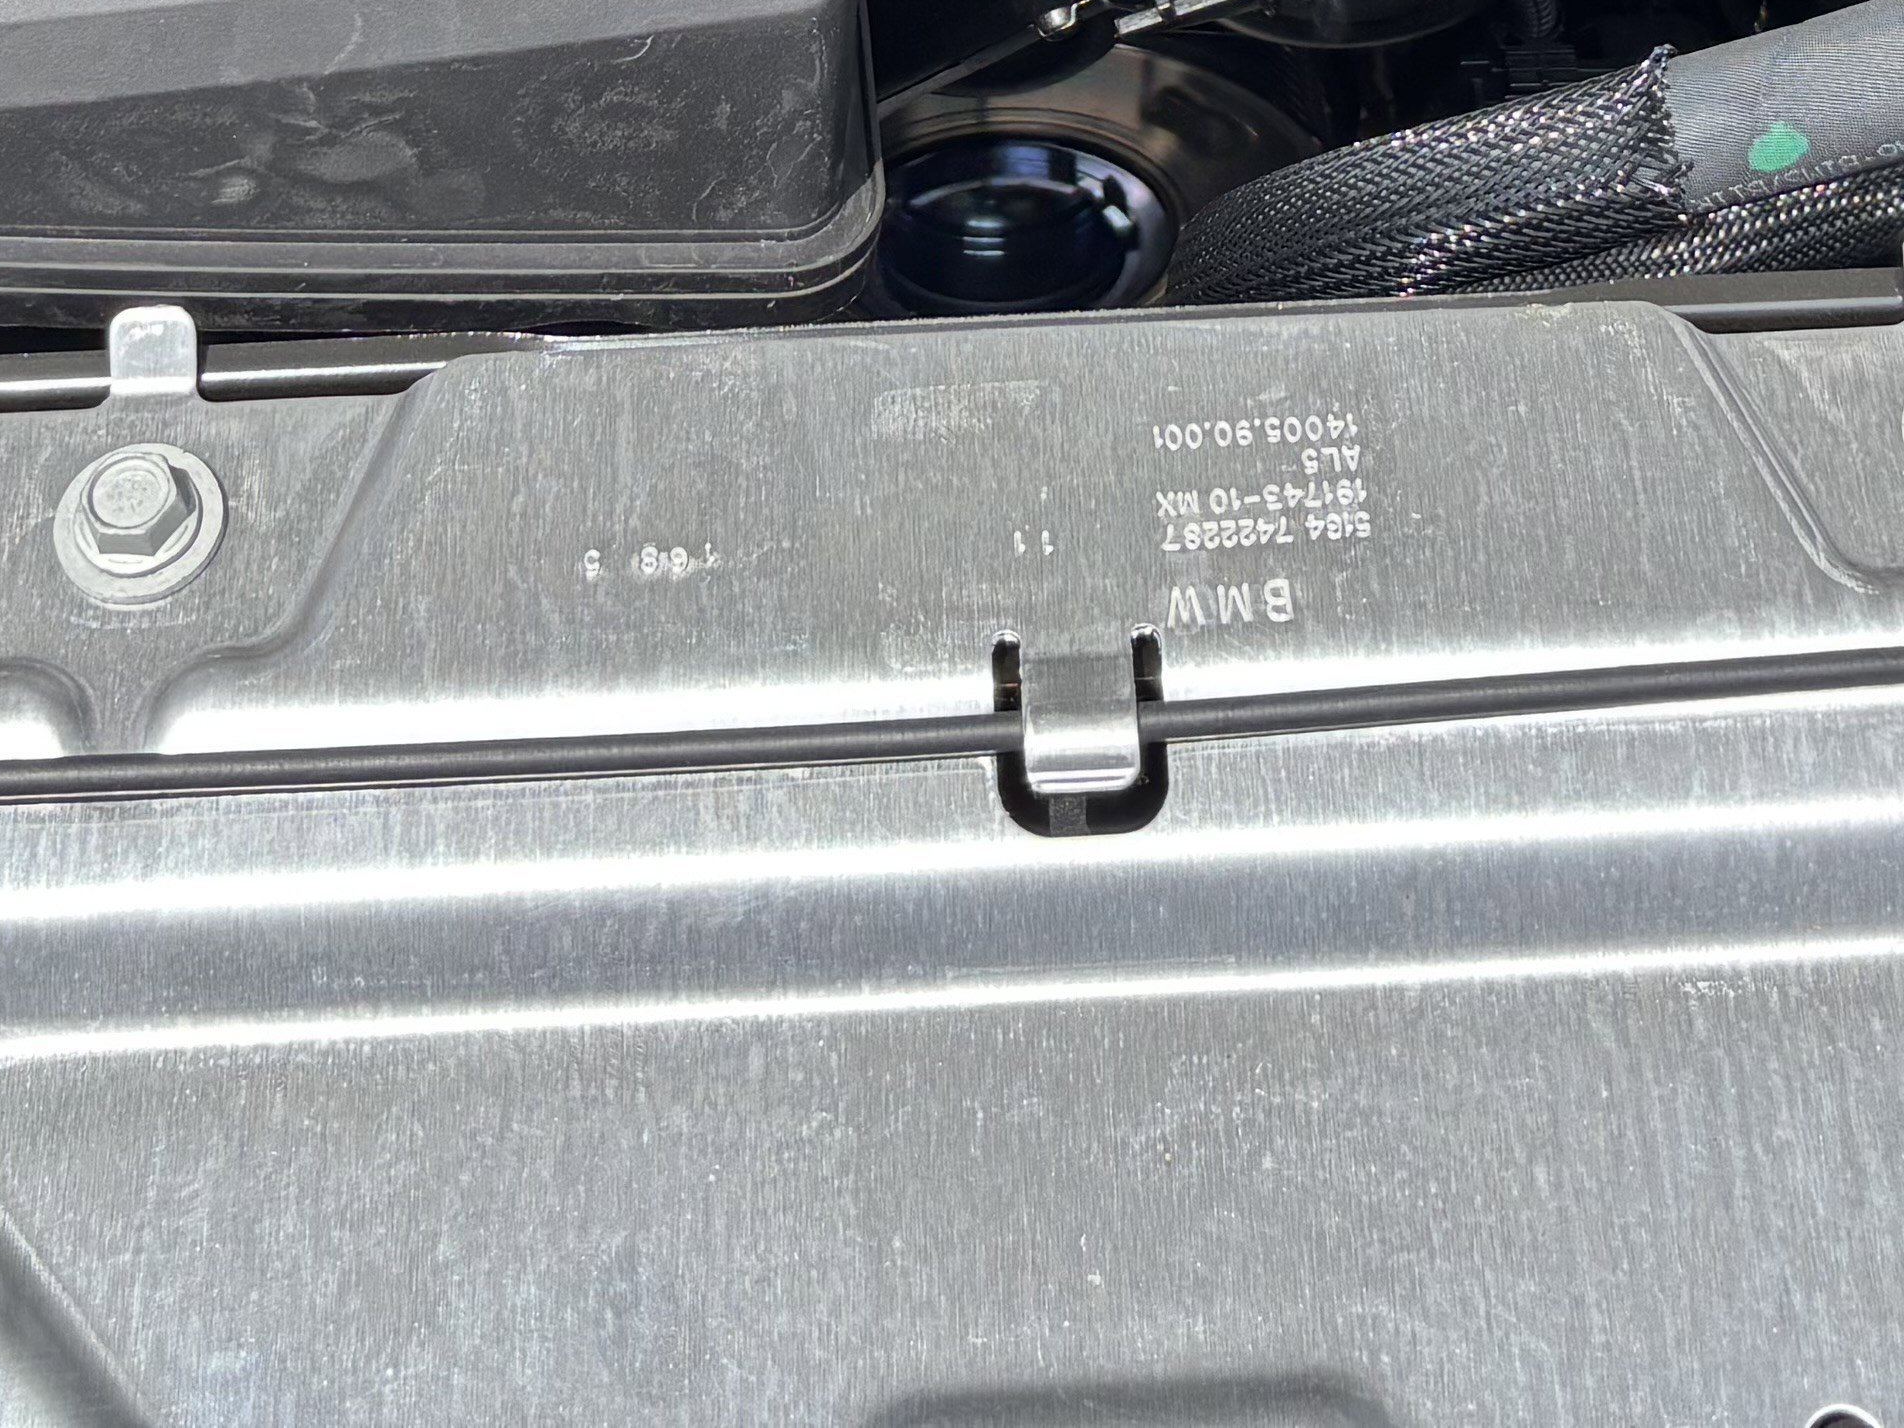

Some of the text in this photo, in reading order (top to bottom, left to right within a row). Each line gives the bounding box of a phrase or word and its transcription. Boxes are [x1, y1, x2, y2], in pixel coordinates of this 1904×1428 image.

[1152, 412, 1359, 452] 14005.90.001
[1300, 444, 1361, 475] AL5
[1156, 477, 1367, 518] 191743-10 MX
[1161, 510, 1372, 552] 5164 7422287
[1166, 577, 1295, 630] BMW
